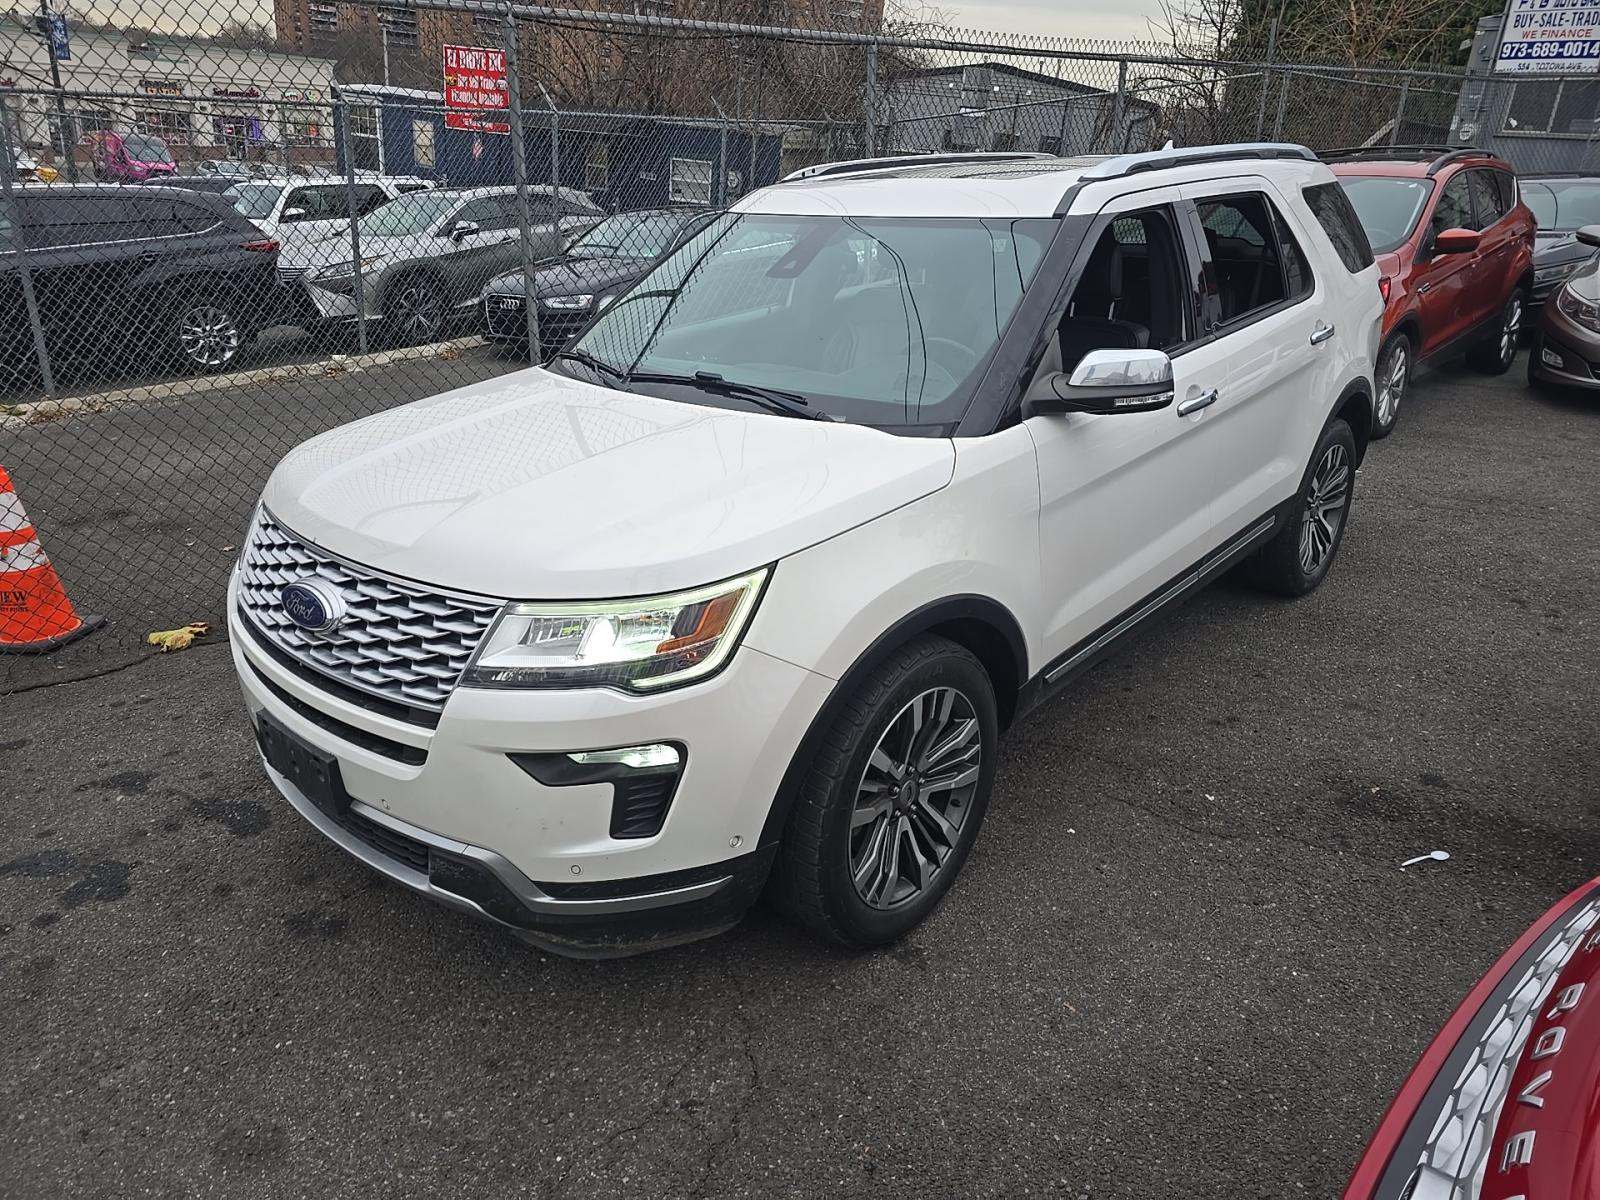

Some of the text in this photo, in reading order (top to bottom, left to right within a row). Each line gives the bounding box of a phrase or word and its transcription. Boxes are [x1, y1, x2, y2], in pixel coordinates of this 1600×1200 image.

[1522, 28, 1593, 39] WE FINANCE
[1501, 41, 1600, 58] 973-689-0014
[286, 590, 316, 621] Ford
